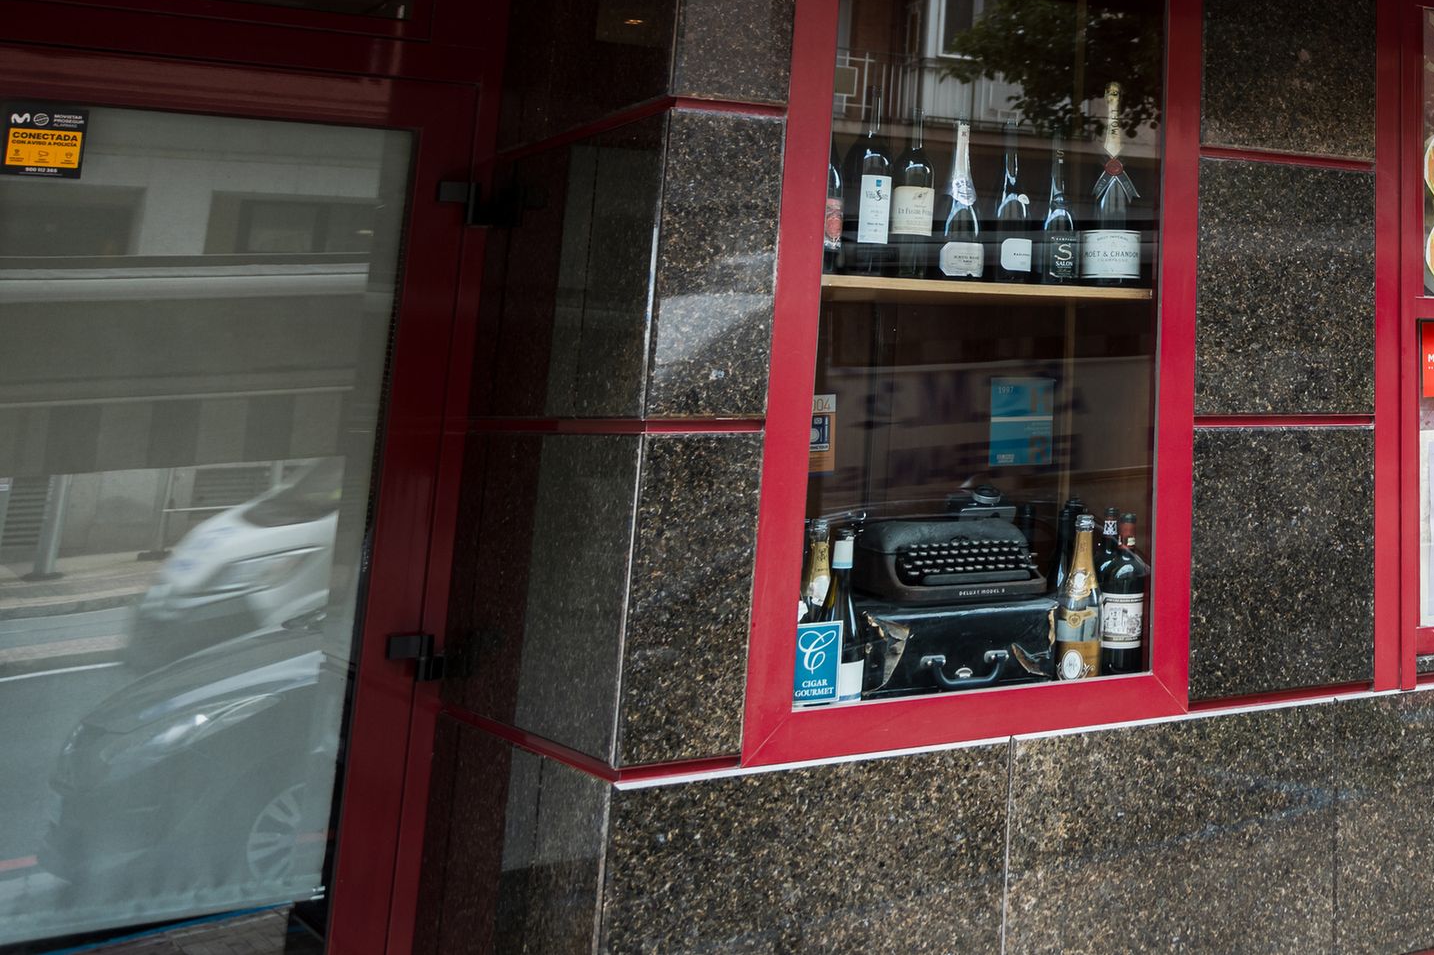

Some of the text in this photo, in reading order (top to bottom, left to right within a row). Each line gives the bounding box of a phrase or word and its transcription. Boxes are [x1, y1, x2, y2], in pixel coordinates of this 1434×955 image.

[12, 131, 78, 141] CONECTADA
[802, 679, 828, 688] CIGAR
[794, 686, 835, 697] GOURMET
